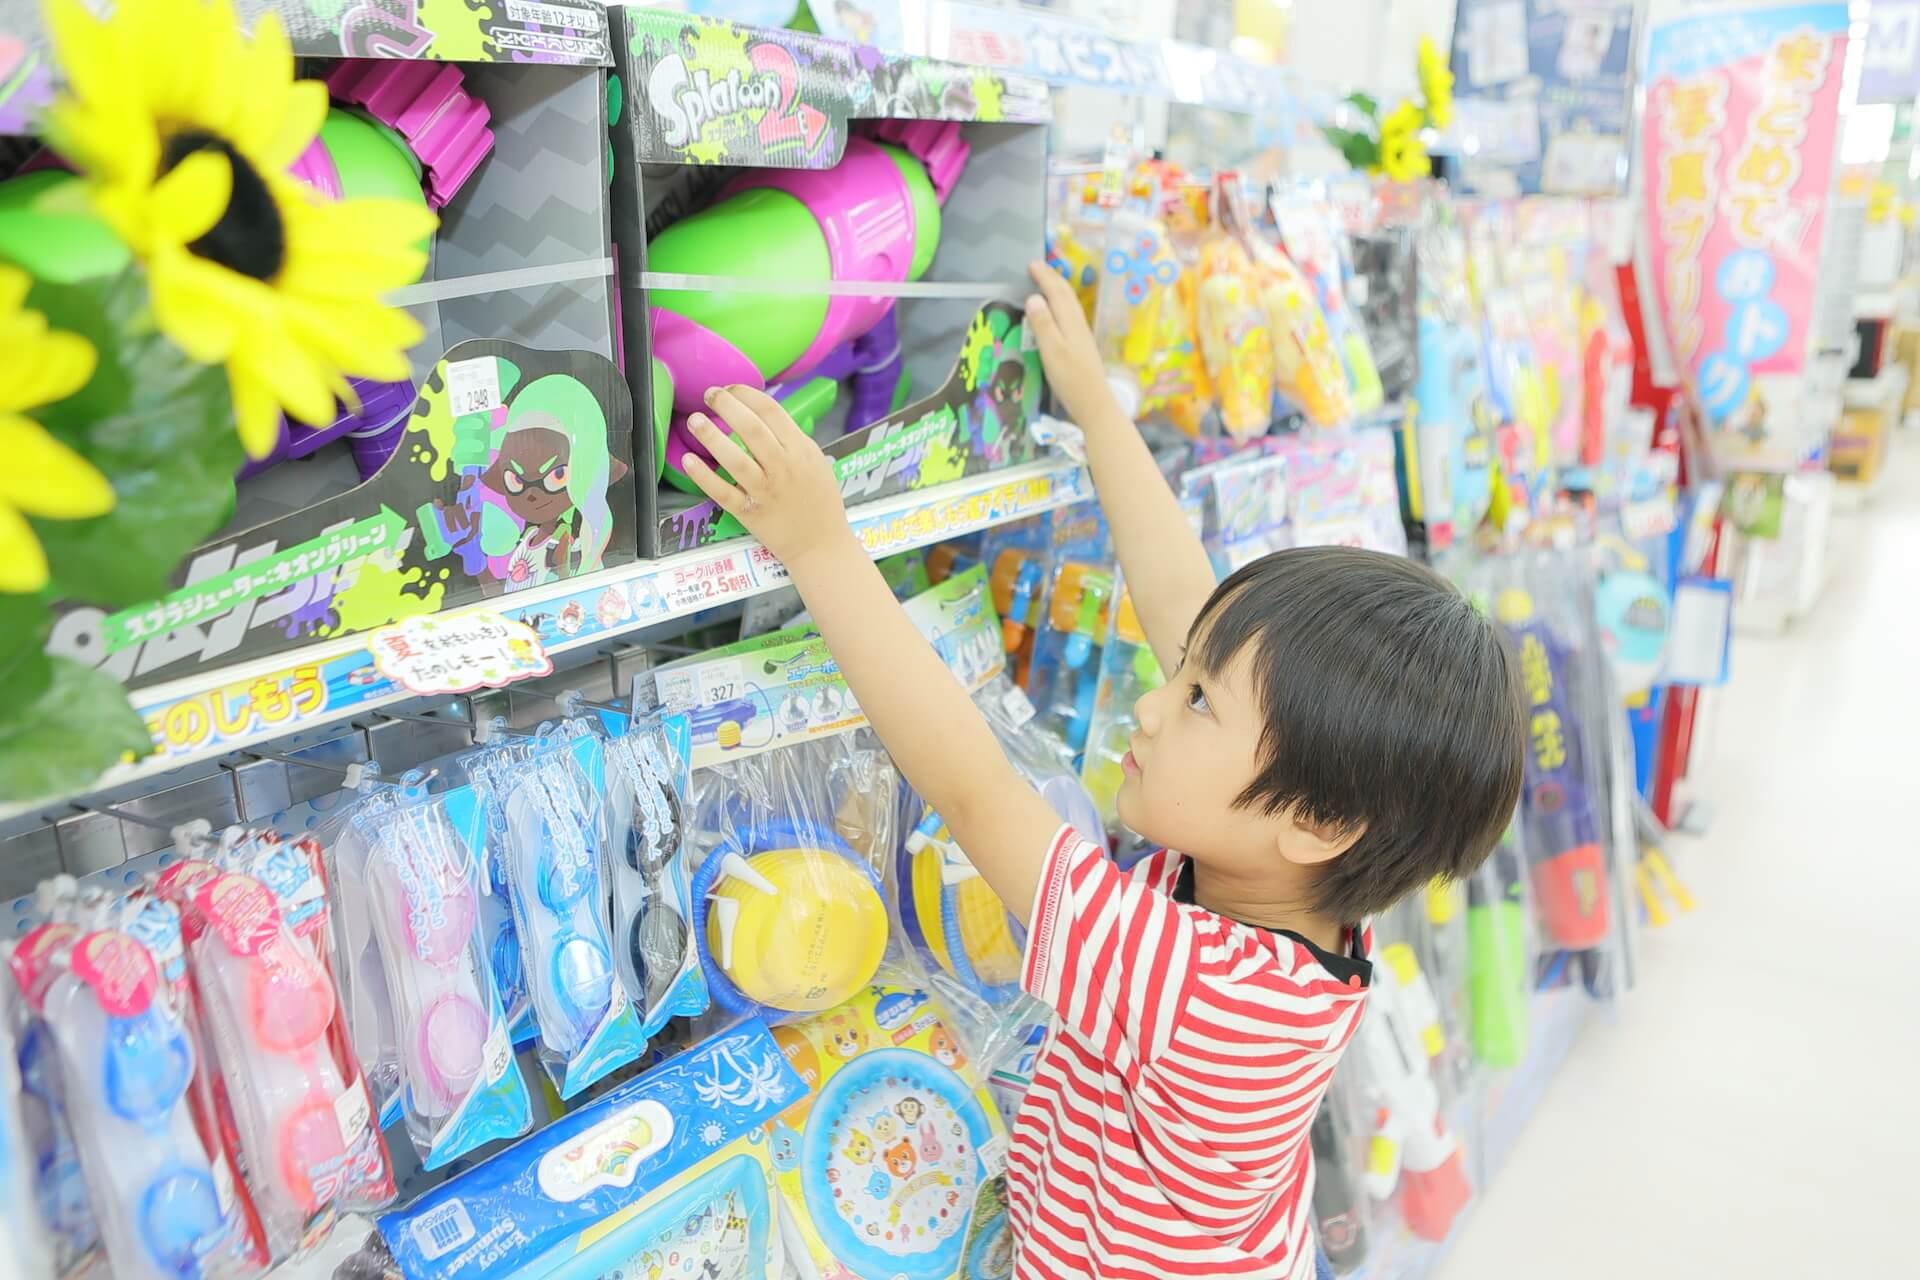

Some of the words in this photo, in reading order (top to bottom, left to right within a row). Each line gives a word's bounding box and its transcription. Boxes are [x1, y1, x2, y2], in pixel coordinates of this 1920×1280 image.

[649, 54, 781, 148] Splatoon
[710, 683, 735, 702] 327
[480, 1228, 531, 1272] Enjoy
